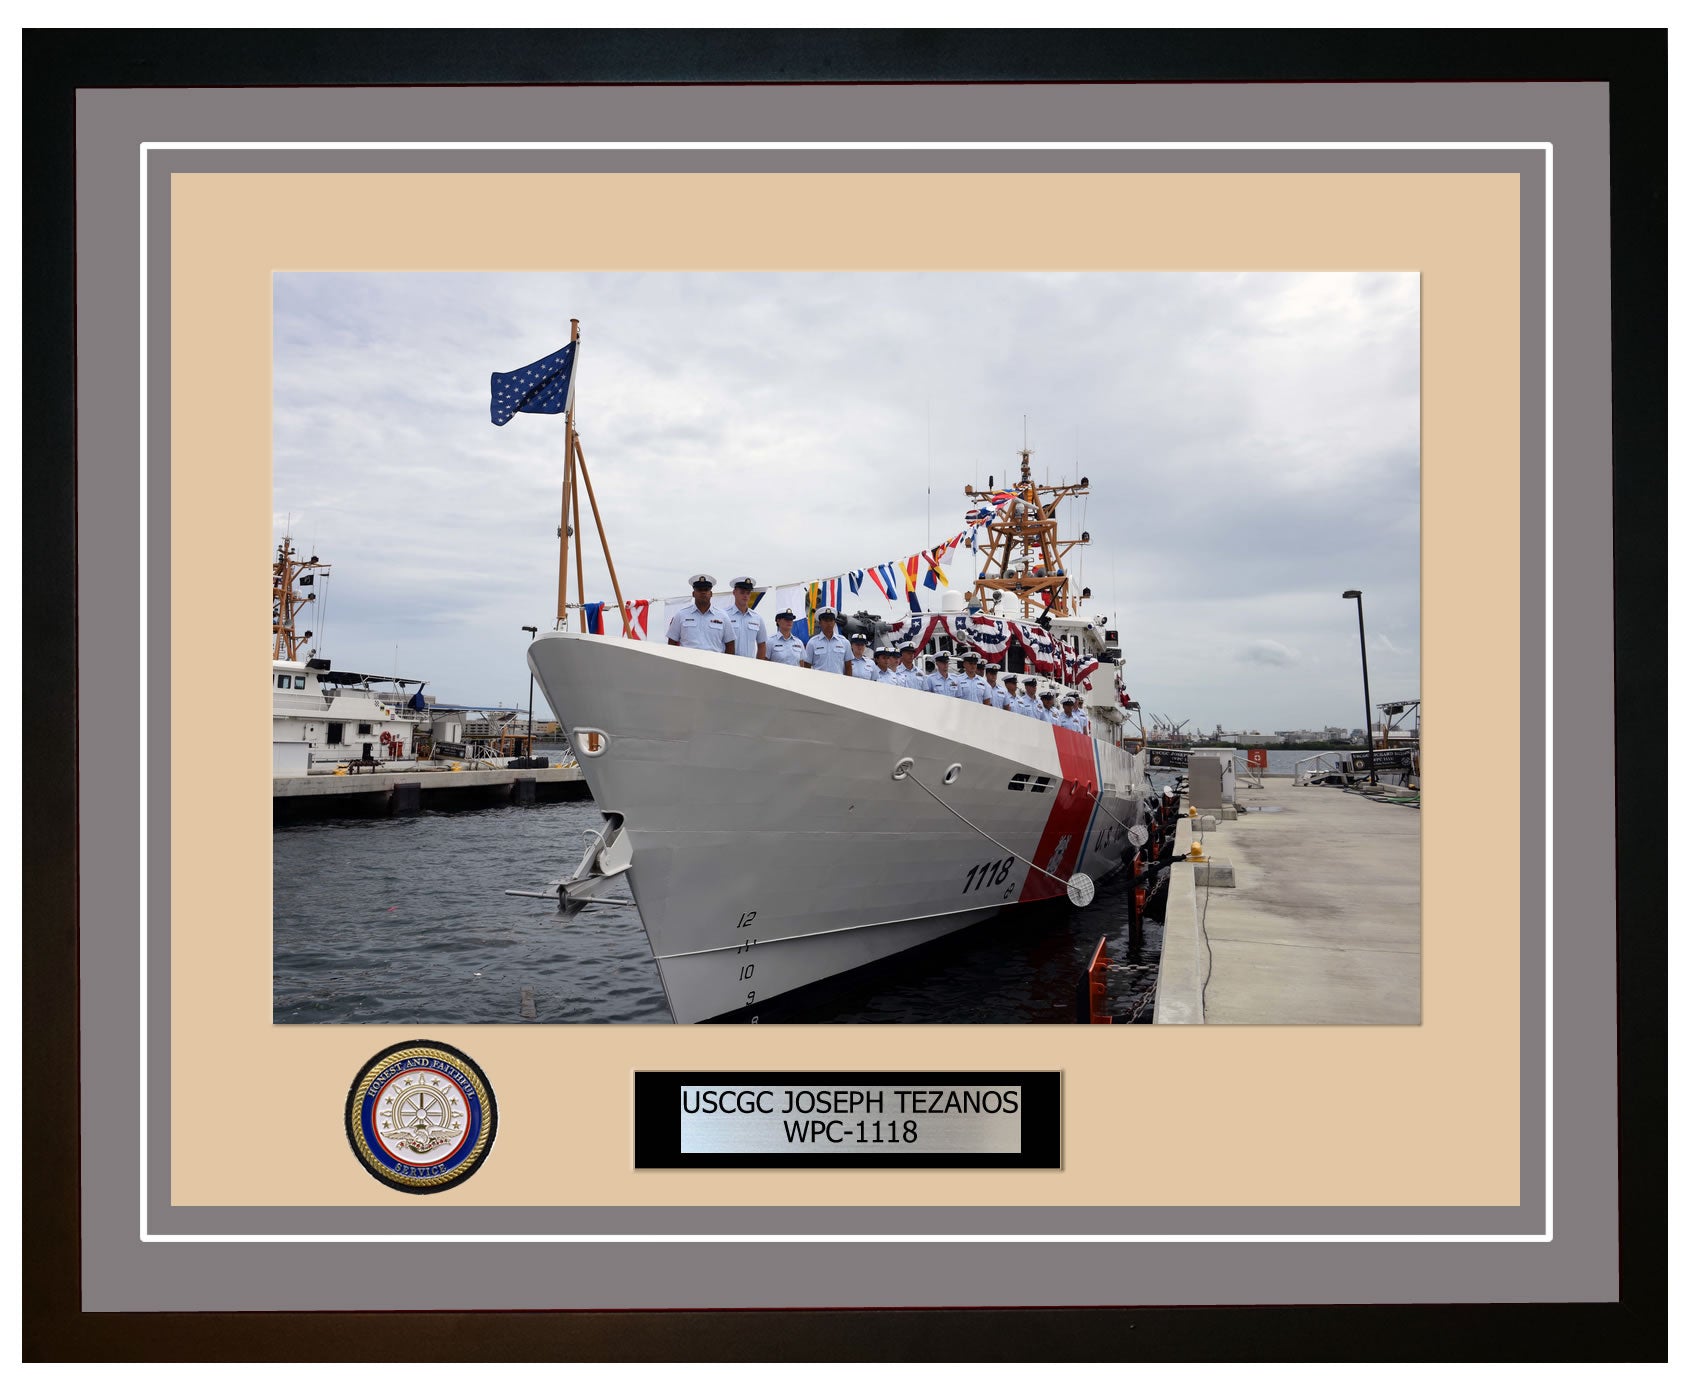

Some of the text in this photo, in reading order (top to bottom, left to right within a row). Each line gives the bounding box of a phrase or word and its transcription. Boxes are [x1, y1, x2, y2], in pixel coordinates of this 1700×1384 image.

[962, 856, 1015, 894] 1118
[736, 911, 757, 929] 12
[739, 963, 755, 981] 10
[746, 990, 756, 1007] 9
[367, 1058, 477, 1100] HONEST AND FAITHFUL
[683, 1090, 1019, 1114] USCGC JOSEPH TEZANOS
[784, 1120, 918, 1143] WPC-1118
[394, 1163, 447, 1177] SERVICE
